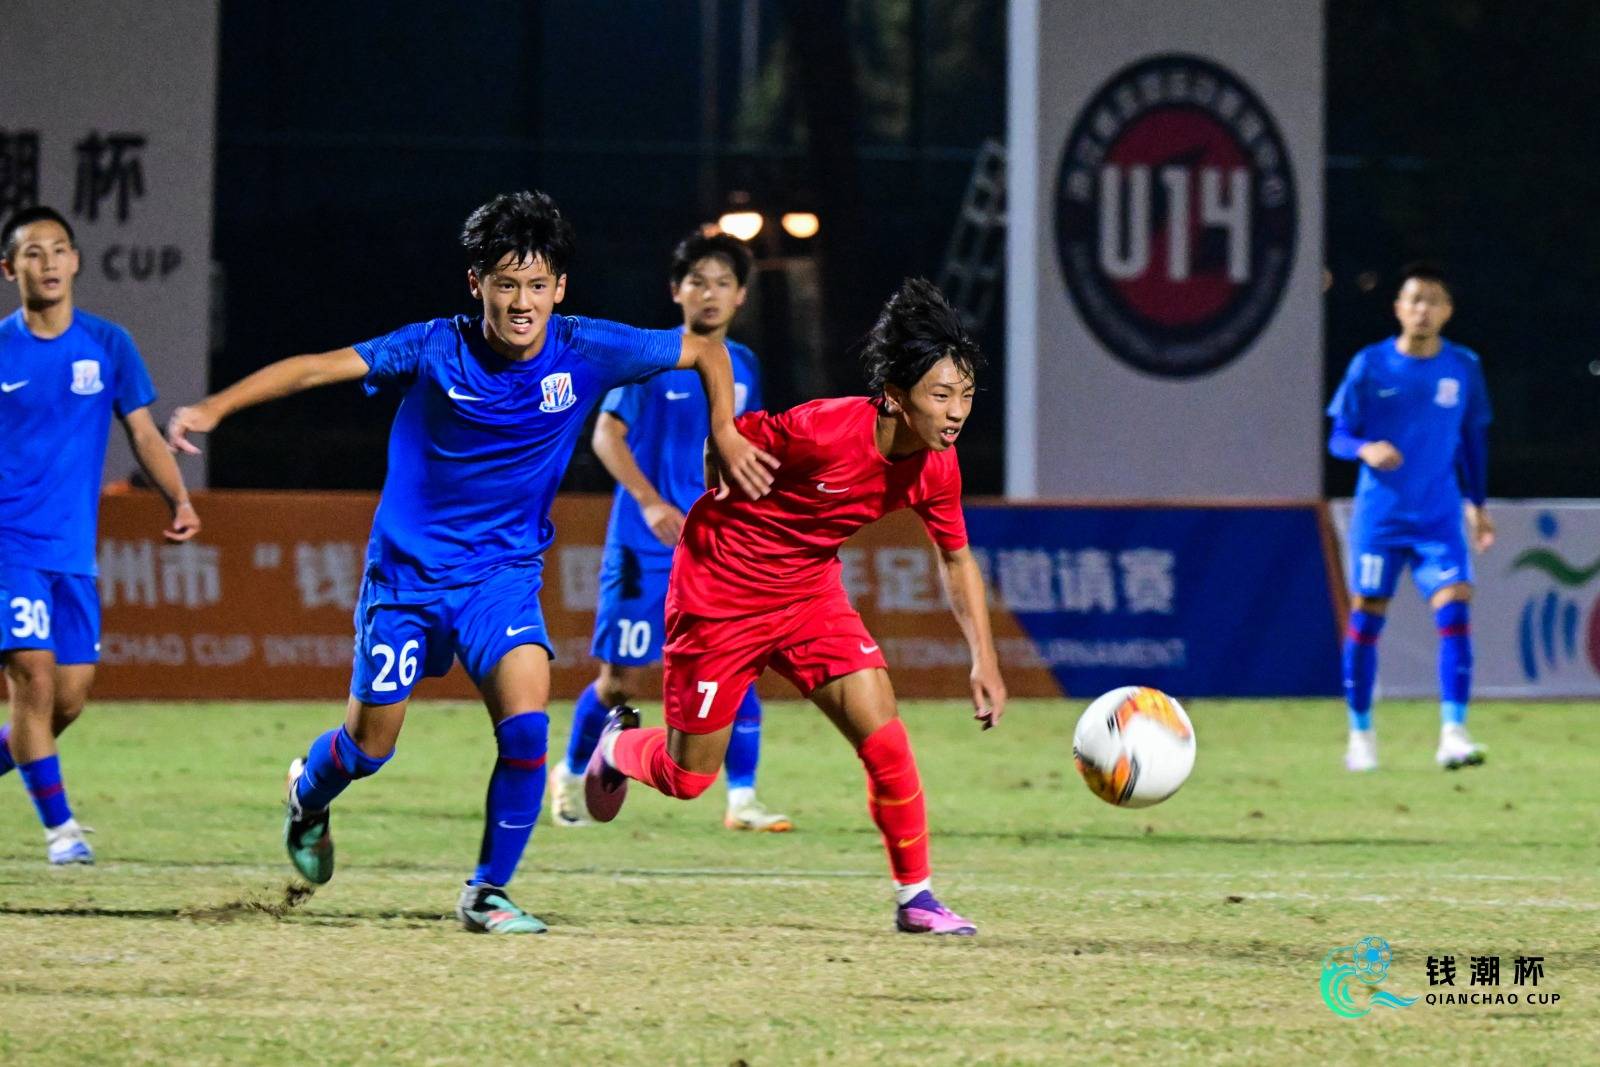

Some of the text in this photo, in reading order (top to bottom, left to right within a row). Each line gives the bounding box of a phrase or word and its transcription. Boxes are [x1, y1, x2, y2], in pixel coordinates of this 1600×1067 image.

[1099, 164, 1251, 282] U14
[102, 244, 182, 281] CUP
[1360, 553, 1384, 589] 11
[10, 596, 50, 640] 30
[617, 618, 652, 658] 10
[371, 639, 419, 692] 26
[697, 681, 718, 719] 7
